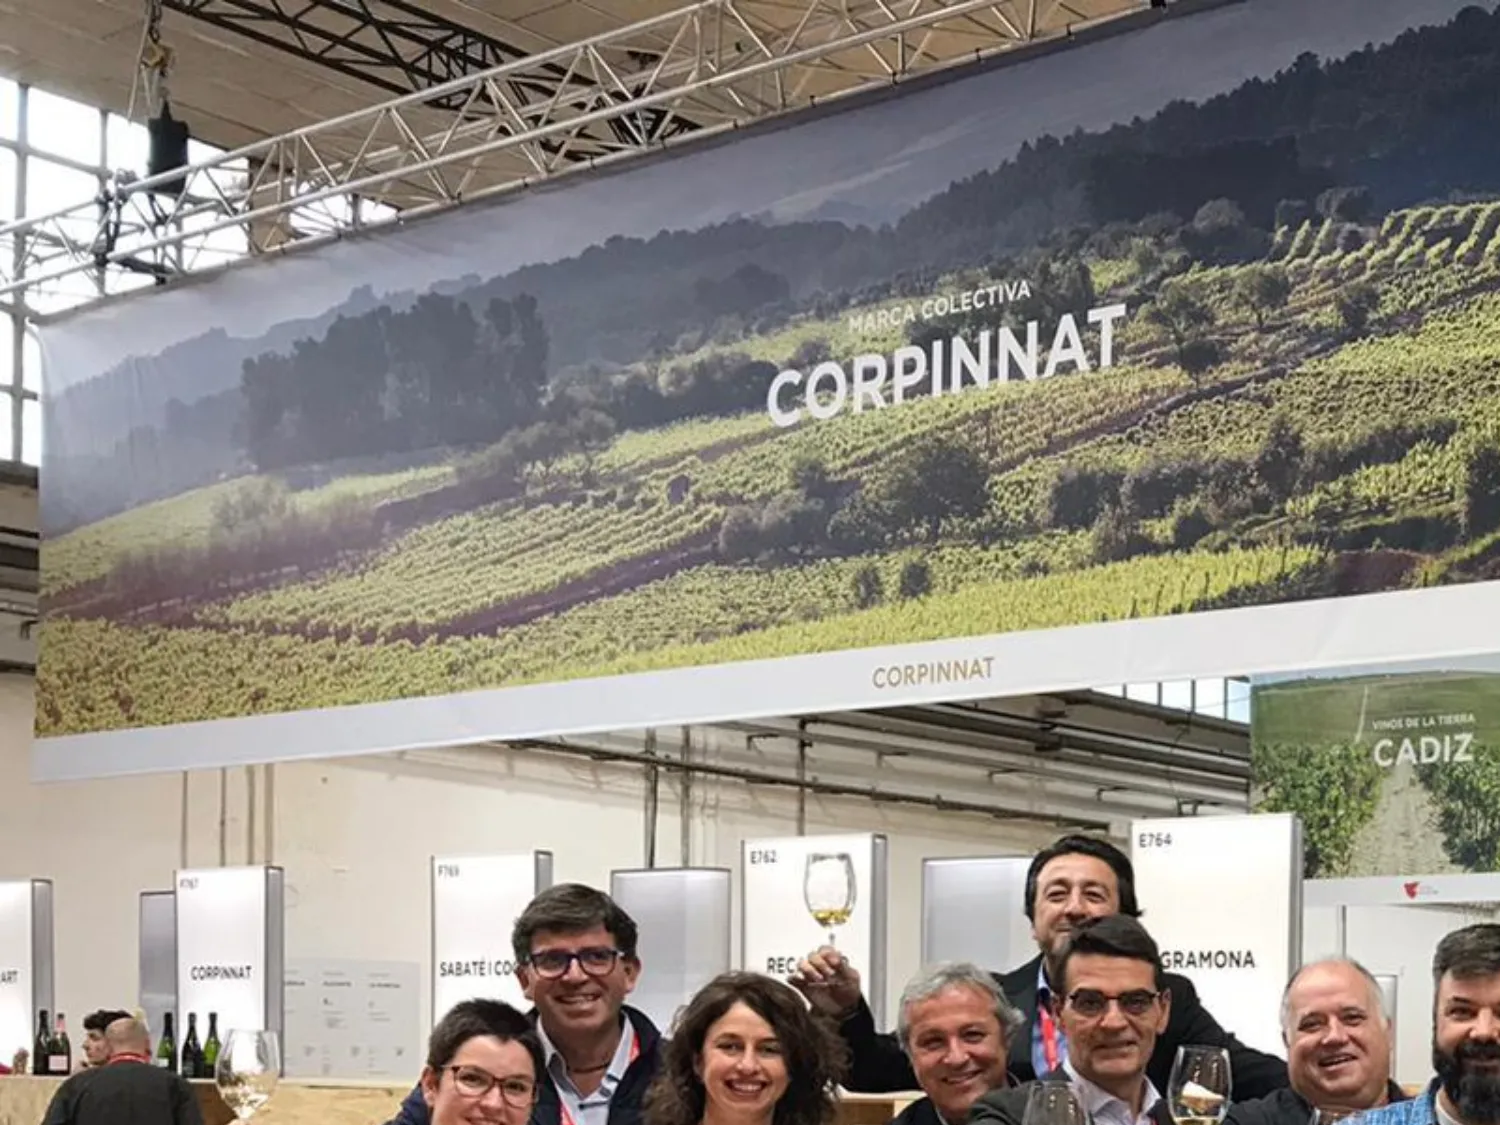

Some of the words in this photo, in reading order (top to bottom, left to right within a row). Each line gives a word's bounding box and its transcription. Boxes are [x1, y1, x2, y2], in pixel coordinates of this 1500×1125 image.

[849, 304, 916, 332] MARCA
[921, 280, 1031, 319] COLECTIVA
[766, 303, 1126, 428] CORPINNAT
[872, 656, 995, 689] CORPINNAT
[1372, 717, 1403, 730] VINOS
[1406, 717, 1420, 728] DE
[1422, 715, 1436, 728] LA
[1438, 713, 1477, 725] TIERRA
[1373, 732, 1475, 767] CADIZ
[1138, 832, 1173, 848] E764
[750, 850, 778, 865] E762
[766, 956, 797, 974] REC
[1161, 949, 1257, 969] GRAMONA
[1, 970, 19, 984] ART
[190, 965, 252, 981] CORPINNAT
